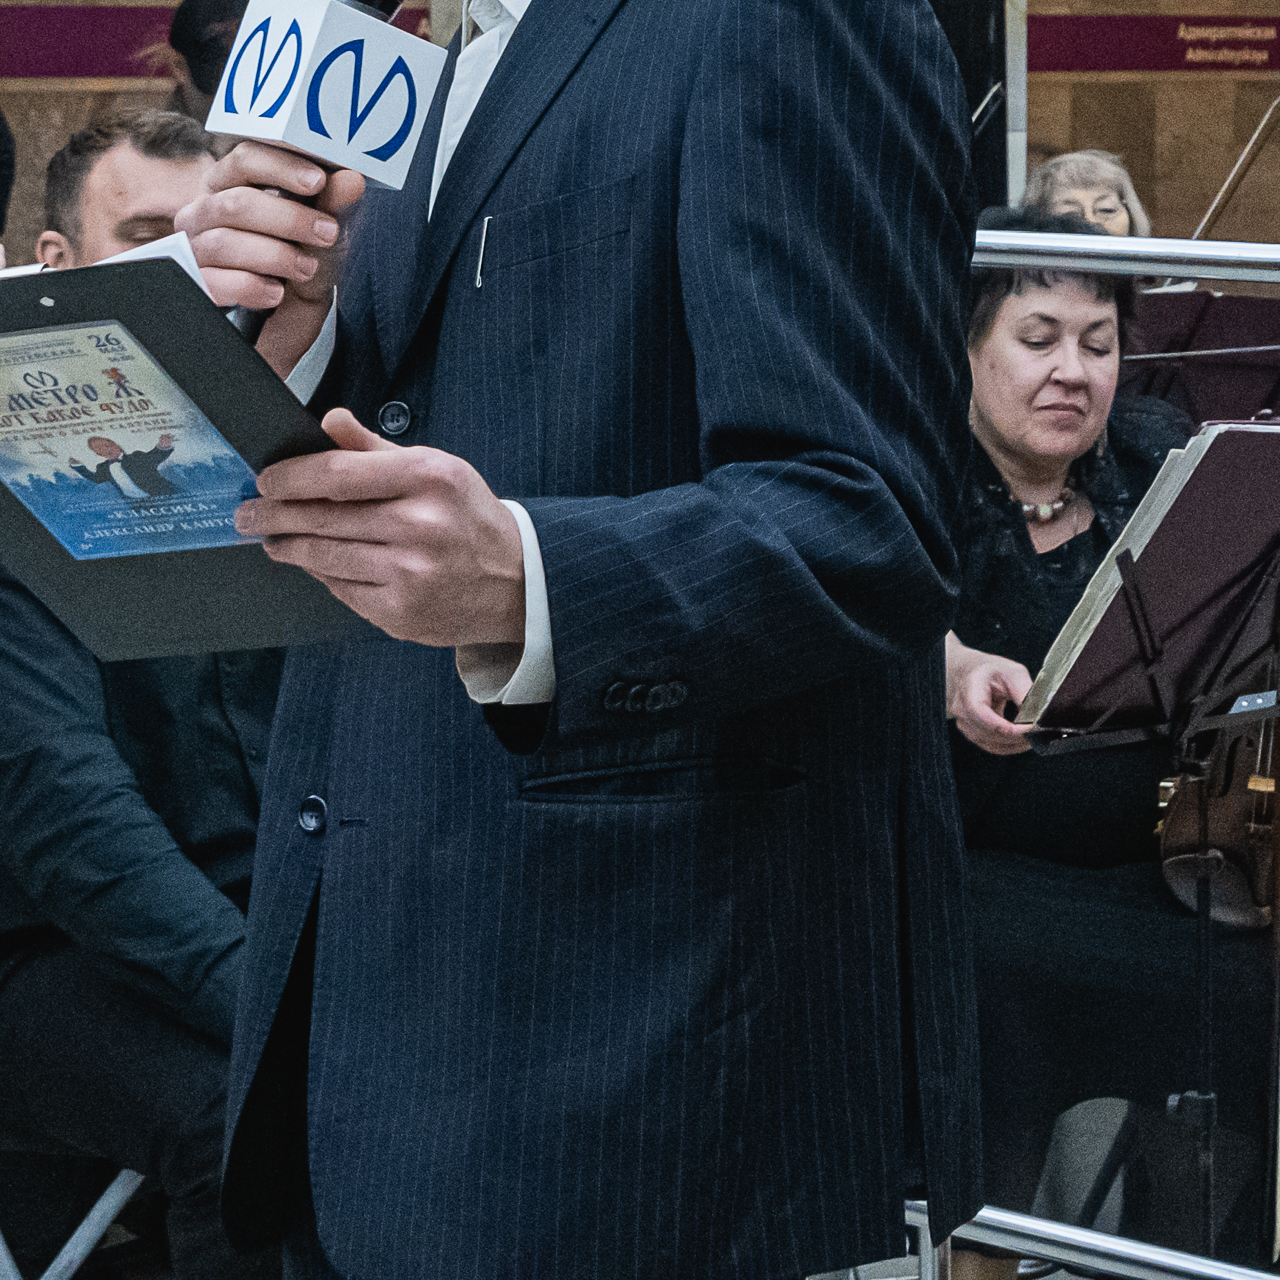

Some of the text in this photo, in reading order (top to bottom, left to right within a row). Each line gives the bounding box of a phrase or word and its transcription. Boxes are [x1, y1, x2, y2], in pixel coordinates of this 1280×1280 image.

[87, 332, 121, 348] 26
[9, 384, 99, 412] МЕТРО
[31, 404, 95, 424] КАКОЕ
[180, 517, 235, 531] КАНТО
